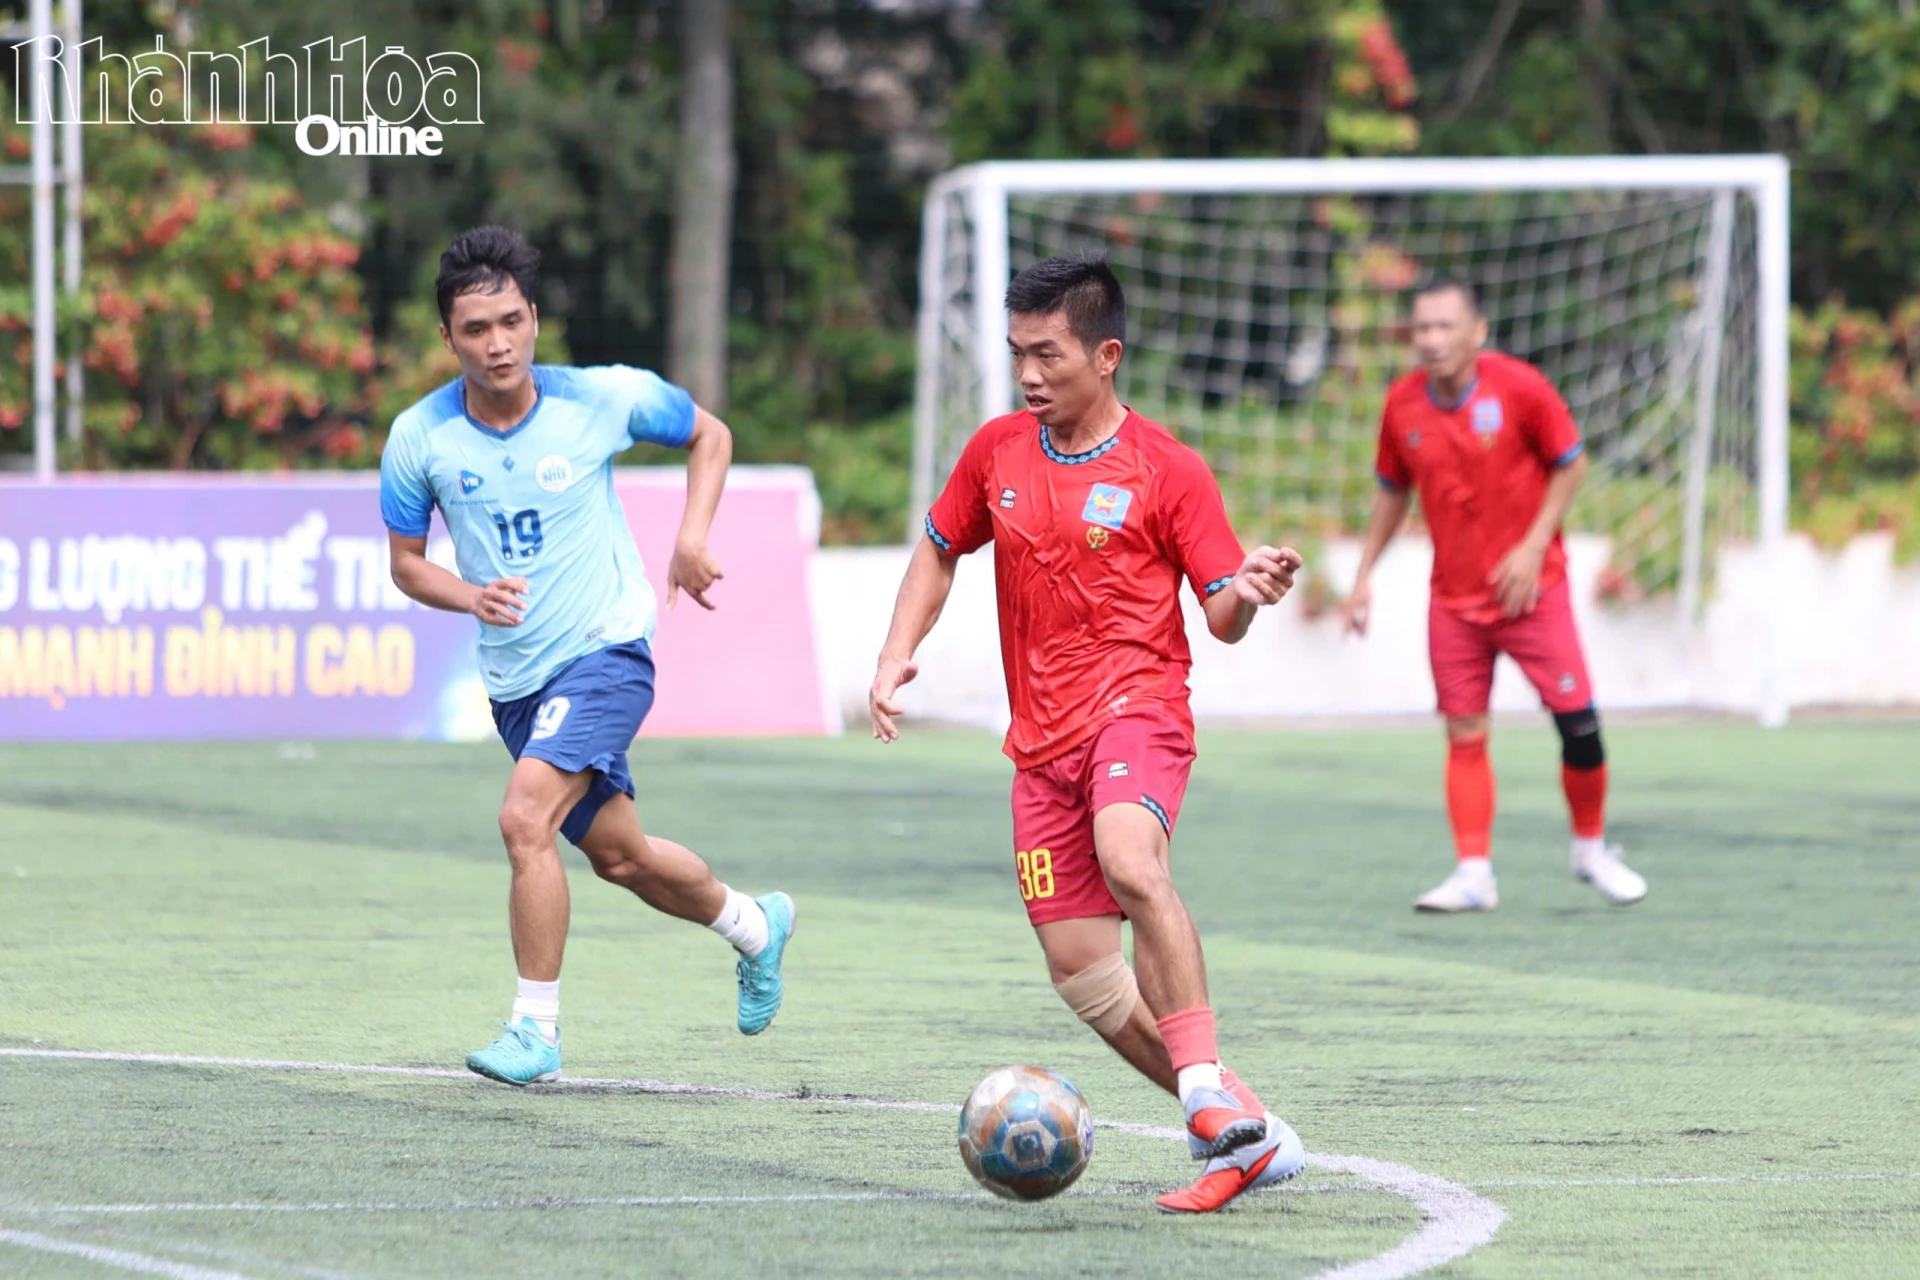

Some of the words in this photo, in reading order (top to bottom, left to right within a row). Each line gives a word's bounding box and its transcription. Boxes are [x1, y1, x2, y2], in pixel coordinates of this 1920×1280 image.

[492, 508, 544, 560] 19
[307, 624, 416, 697] CAO
[1016, 847, 1055, 901] 38
